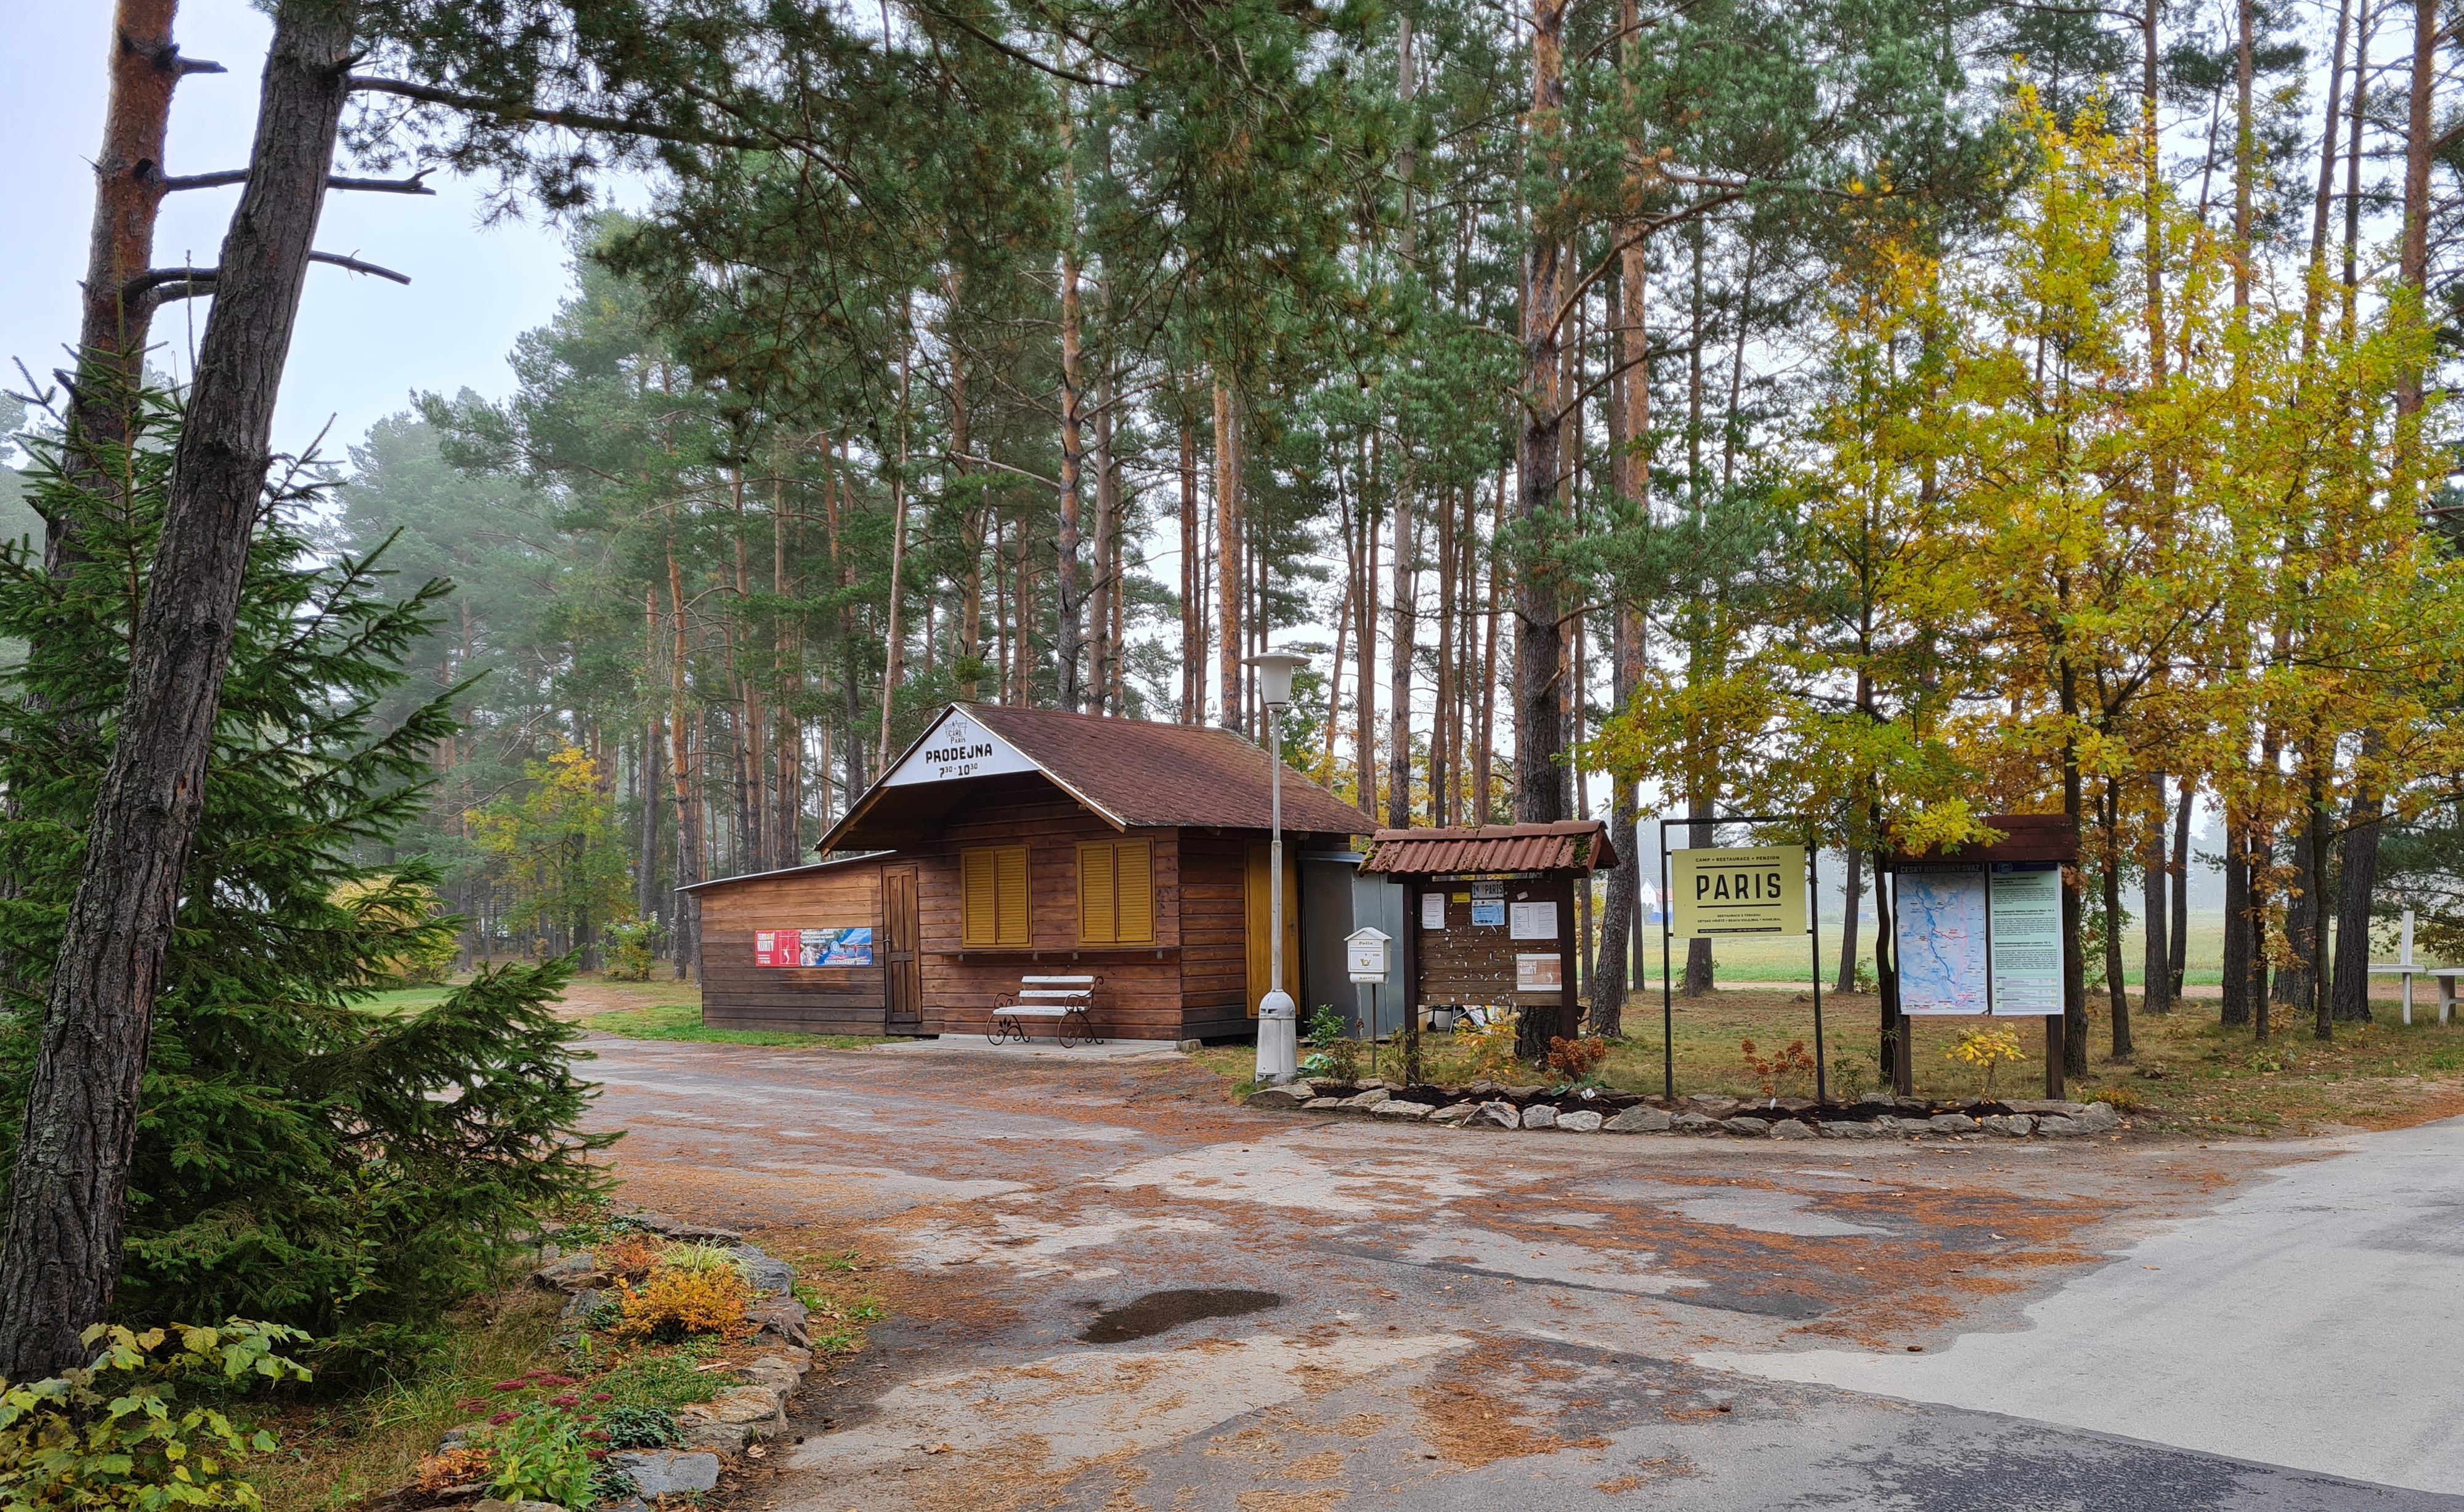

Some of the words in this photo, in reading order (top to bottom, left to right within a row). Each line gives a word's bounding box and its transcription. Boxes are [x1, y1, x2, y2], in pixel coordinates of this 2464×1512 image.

[926, 743, 992, 764] PRODEJNA
[1962, 863, 1980, 872] SVAZ
[1485, 884, 1503, 895] PARIS
[1696, 873, 1781, 900] PARIS
